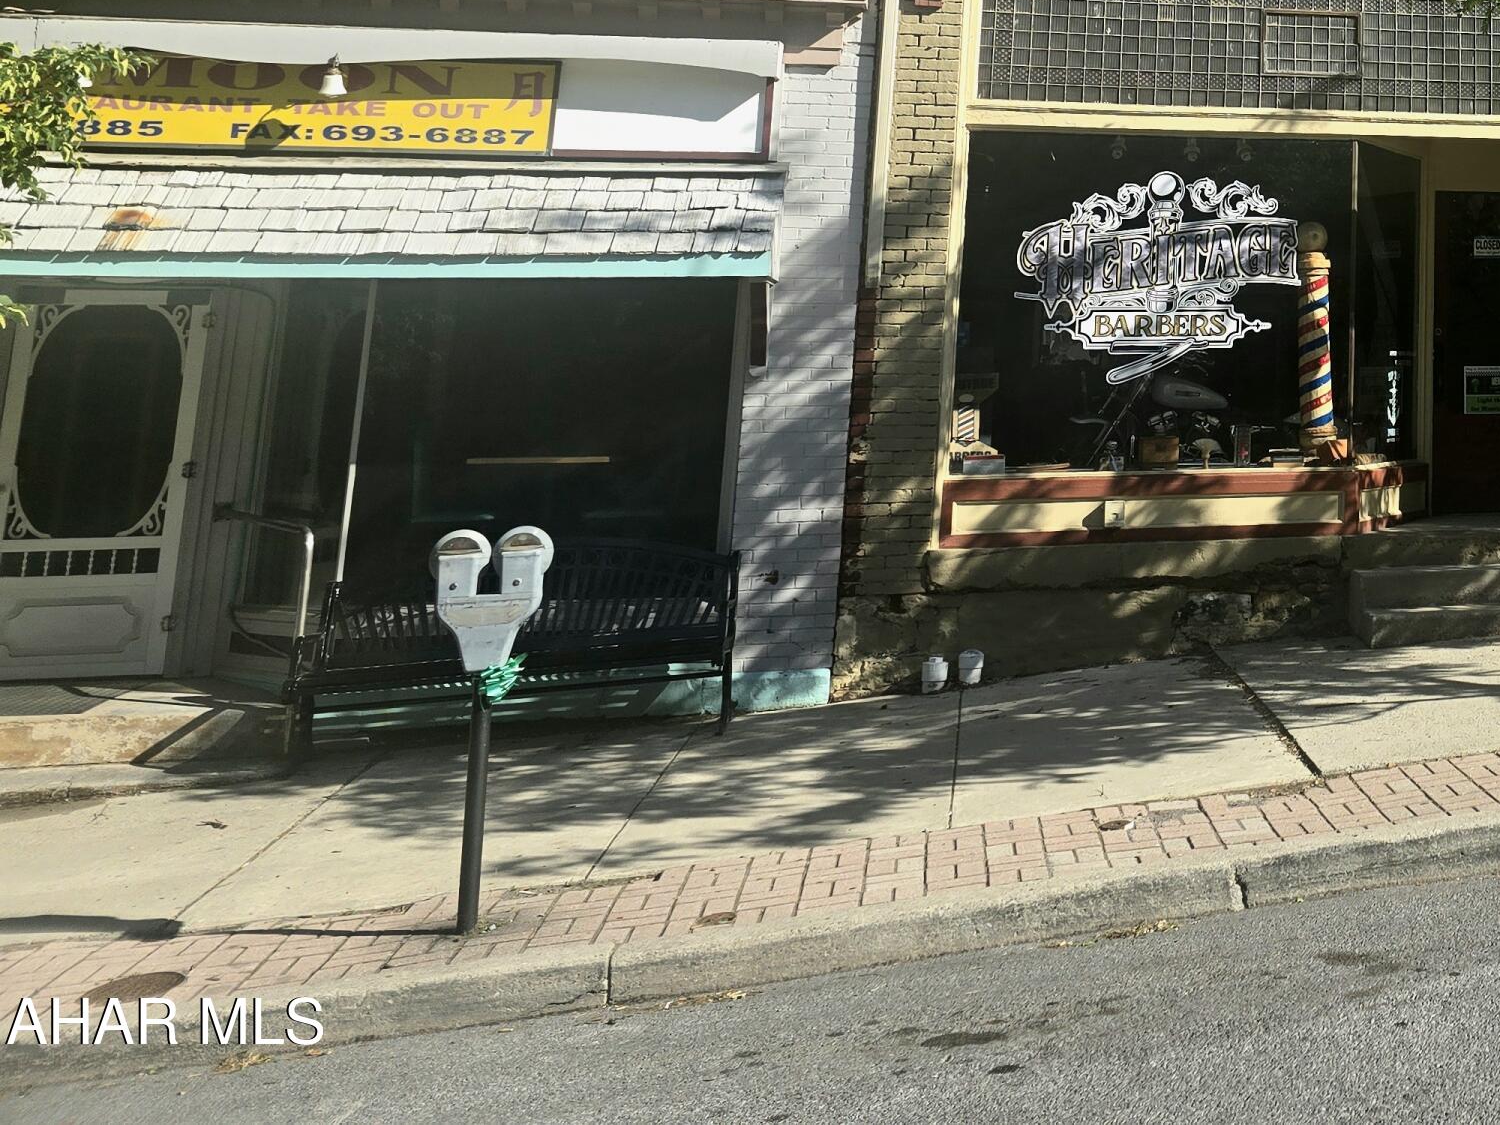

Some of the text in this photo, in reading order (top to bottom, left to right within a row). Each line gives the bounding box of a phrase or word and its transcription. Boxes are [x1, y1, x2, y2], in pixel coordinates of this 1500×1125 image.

[93, 93, 490, 119] AURANT TAKE OUT
[504, 71, 546, 117] 月
[1475, 239, 1500, 250] CLOSED
[1017, 219, 1298, 315] HERITAGE
[1092, 314, 1227, 338] BARBERS
